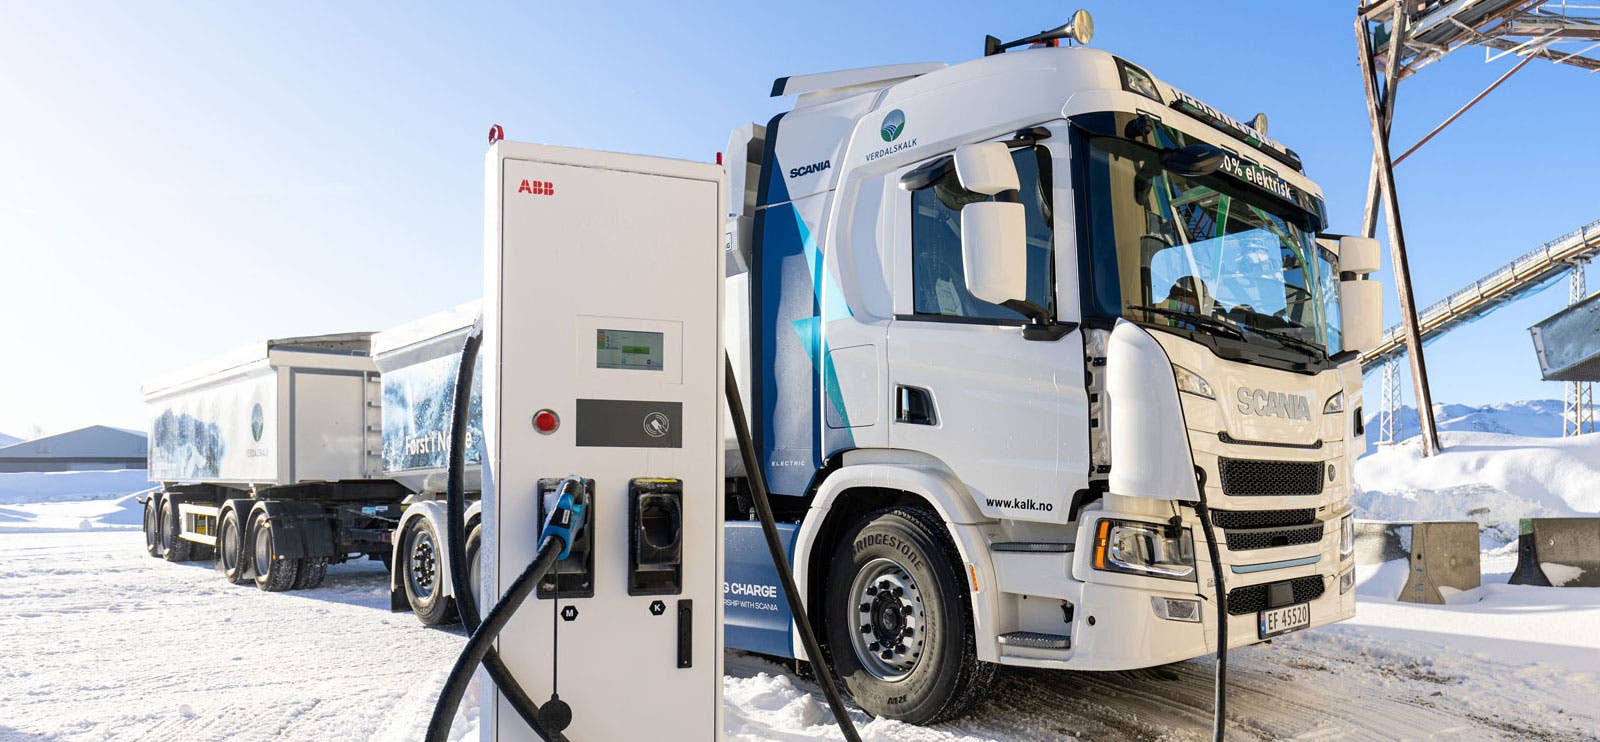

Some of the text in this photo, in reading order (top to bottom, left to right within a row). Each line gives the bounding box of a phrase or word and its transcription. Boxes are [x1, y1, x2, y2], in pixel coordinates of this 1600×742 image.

[865, 137, 918, 162] VERDALSKALK
[789, 159, 831, 179] SCANIA
[1219, 154, 1292, 200] 0% elektrisk
[518, 178, 555, 196] ABB
[1236, 386, 1312, 422] SCANIA
[771, 459, 806, 467] ELECTRIC
[986, 498, 1053, 512] www.kalk.no
[731, 582, 777, 598] CHARGE
[565, 609, 574, 617] M
[654, 604, 661, 612] K
[740, 600, 754, 608] WITH
[755, 602, 778, 611] SCANIA
[1268, 605, 1307, 631] EF 45520
